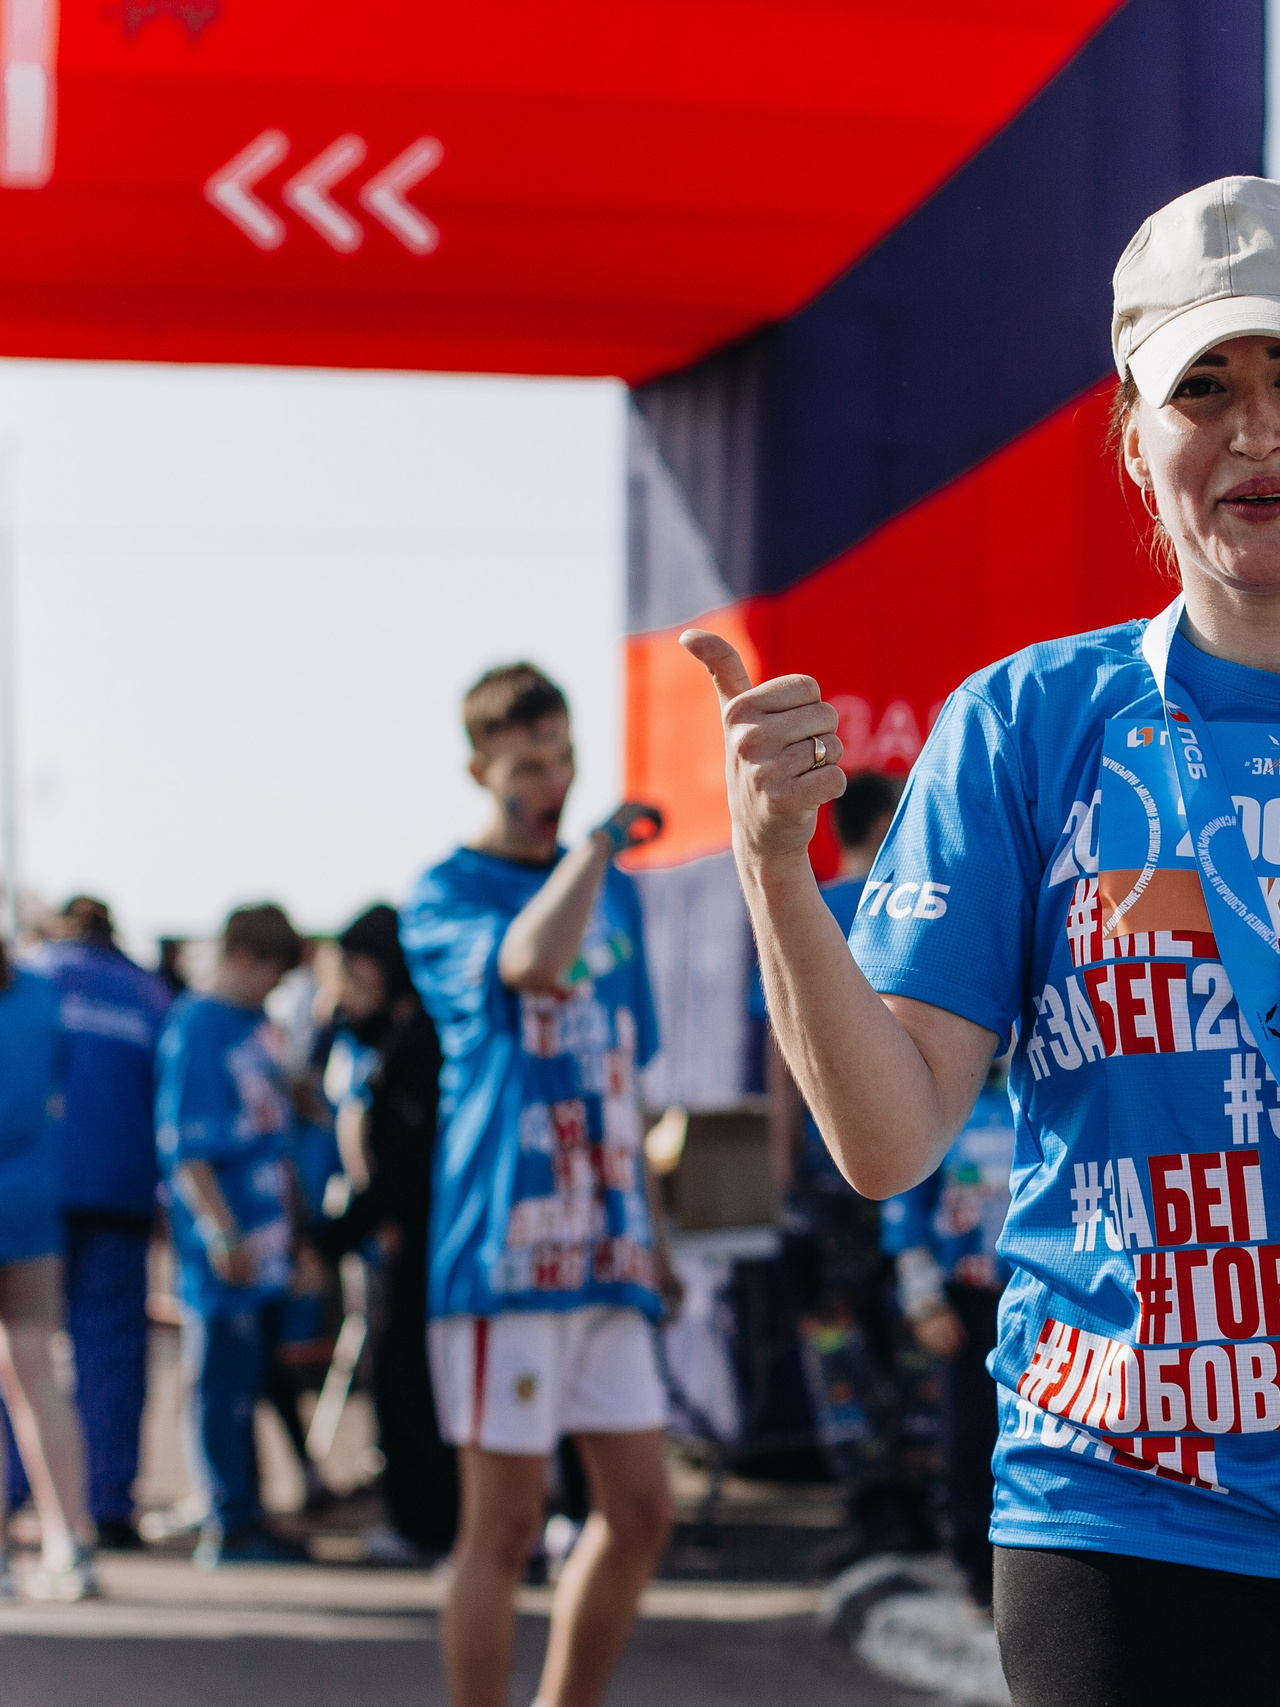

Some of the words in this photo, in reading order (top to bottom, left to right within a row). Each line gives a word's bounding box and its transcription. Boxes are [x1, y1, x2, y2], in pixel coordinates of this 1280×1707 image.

[1177, 726, 1208, 780] ПСБ
[1133, 784, 1158, 817] #ВОСТОРГ
[1147, 817, 1161, 862] #УДИВЛЕНИЕ
[1197, 815, 1237, 878] #САМОВЫРАЖЕНИЕ
[1210, 875, 1248, 918] #ГОРДОСТЬ
[1071, 1150, 1268, 1251] #ЗАБЕГ
